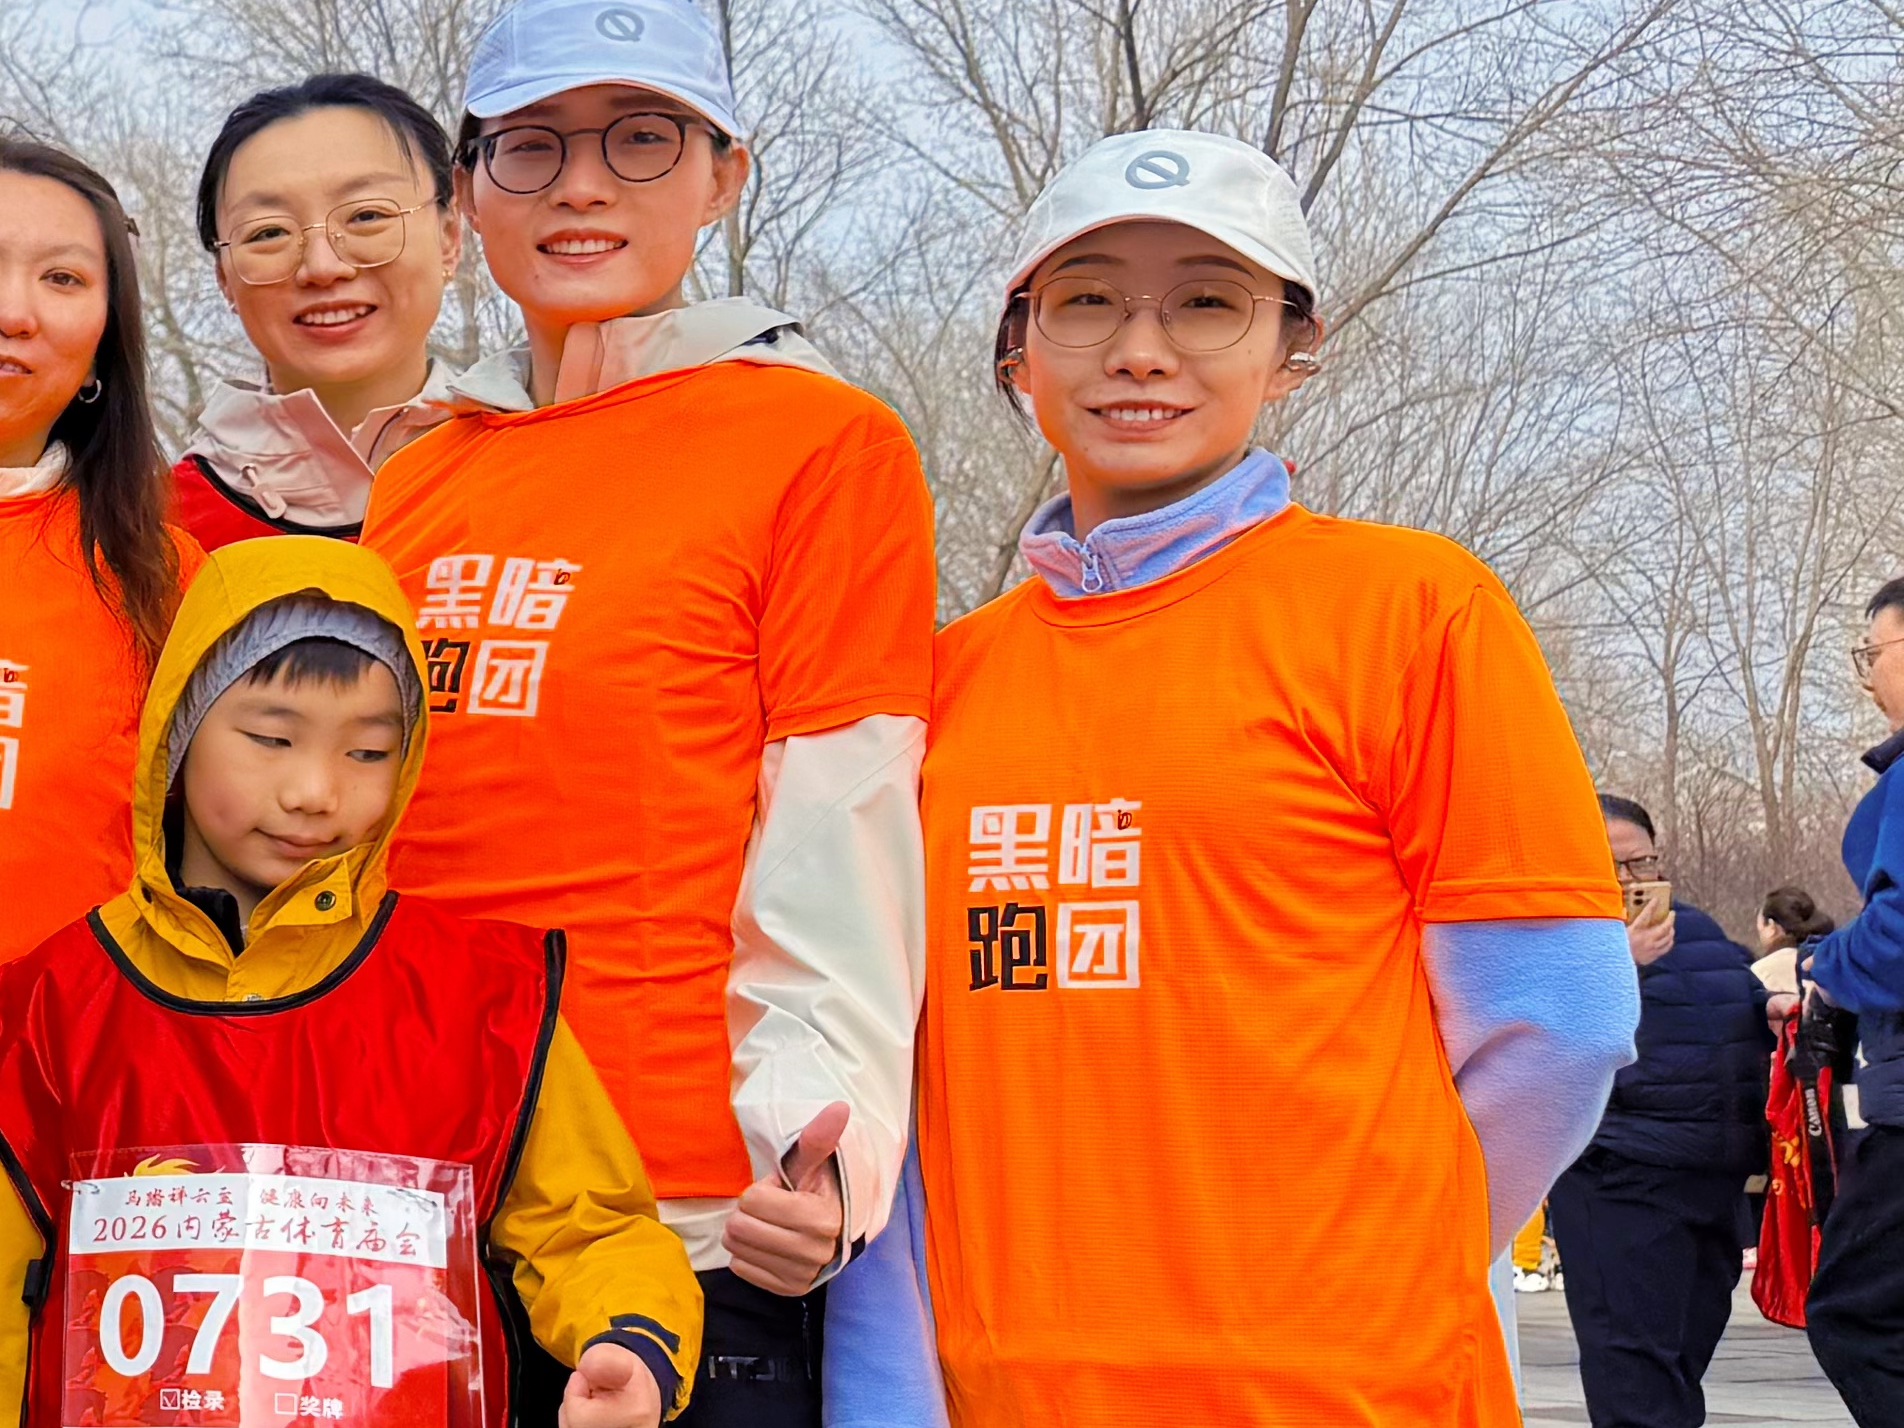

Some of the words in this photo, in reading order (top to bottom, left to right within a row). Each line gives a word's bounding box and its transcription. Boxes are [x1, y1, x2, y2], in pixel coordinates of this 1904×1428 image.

[415, 554, 583, 630] 黑暗
[967, 798, 1142, 892] 黑暗
[967, 900, 1141, 992] 跑团
[1805, 1087, 1823, 1137] Canon
[125, 1186, 234, 1208] 马踏祥云至
[260, 1188, 380, 1217] 健康向未来
[99, 1273, 394, 1389] 0731
[180, 1389, 225, 1411] 检录
[299, 1396, 345, 1420] 奖牌
